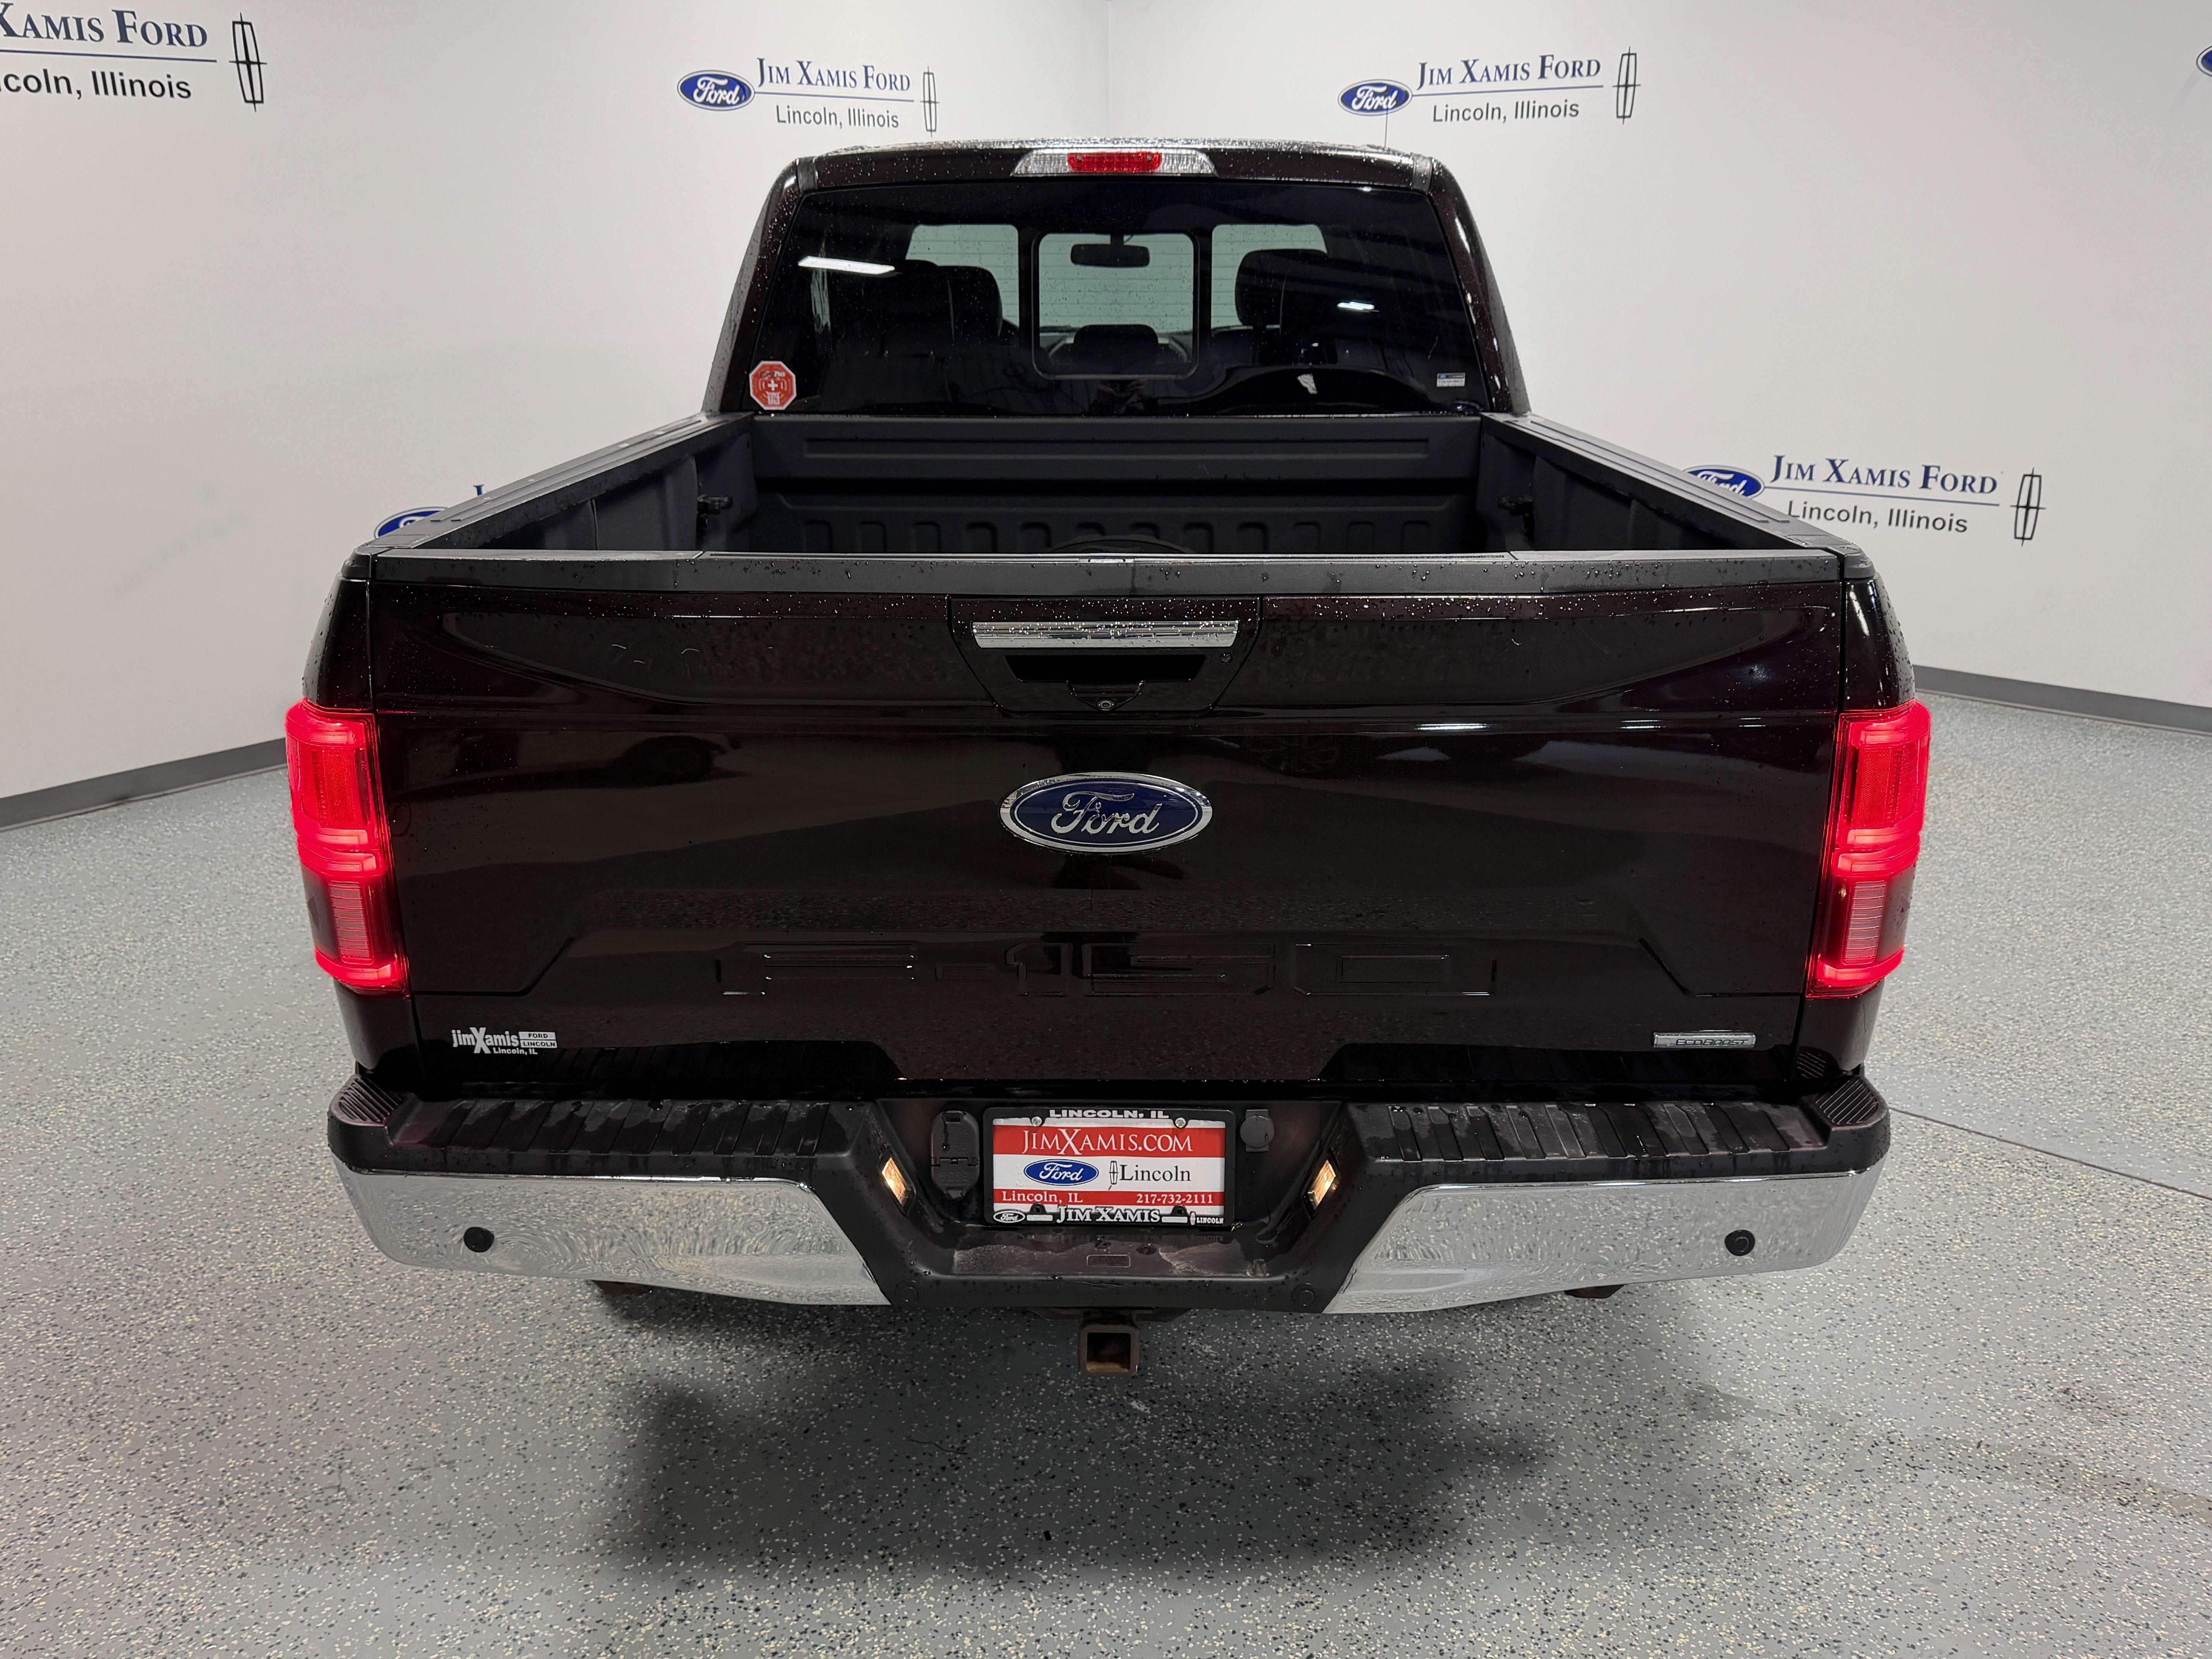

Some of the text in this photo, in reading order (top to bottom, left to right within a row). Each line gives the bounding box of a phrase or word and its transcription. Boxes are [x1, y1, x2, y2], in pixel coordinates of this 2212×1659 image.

[112, 10, 207, 47] FORD
[757, 58, 910, 91] JIM XAMIS FORD
[1417, 54, 1601, 90] JIM XAMIS FORD
[91, 71, 191, 99] Illinois
[693, 76, 740, 105] Ford
[1352, 85, 1397, 110] Ford
[776, 105, 899, 129] Lincoln, Illinois
[1433, 100, 1580, 123] Lincoln, Illinois
[1770, 455, 1997, 494] JIM XAMIS FORD
[1788, 500, 1968, 533] Lincoln, Illinois
[1051, 791, 1162, 834] Ford
[493, 1047, 527, 1055] Lincoln,
[1049, 1109, 1144, 1118] LINCOLN,
[1022, 1128, 1193, 1155] JIMXAMIS.COM
[1039, 1162, 1191, 1182] Ford Lincoln
[1002, 1191, 1083, 1204] Lincoln, IL
[1136, 1194, 1213, 1204] 217-732-2111
[1000, 1213, 1019, 1222] Ford
[1057, 1206, 1160, 1223] JIM XAMIS
